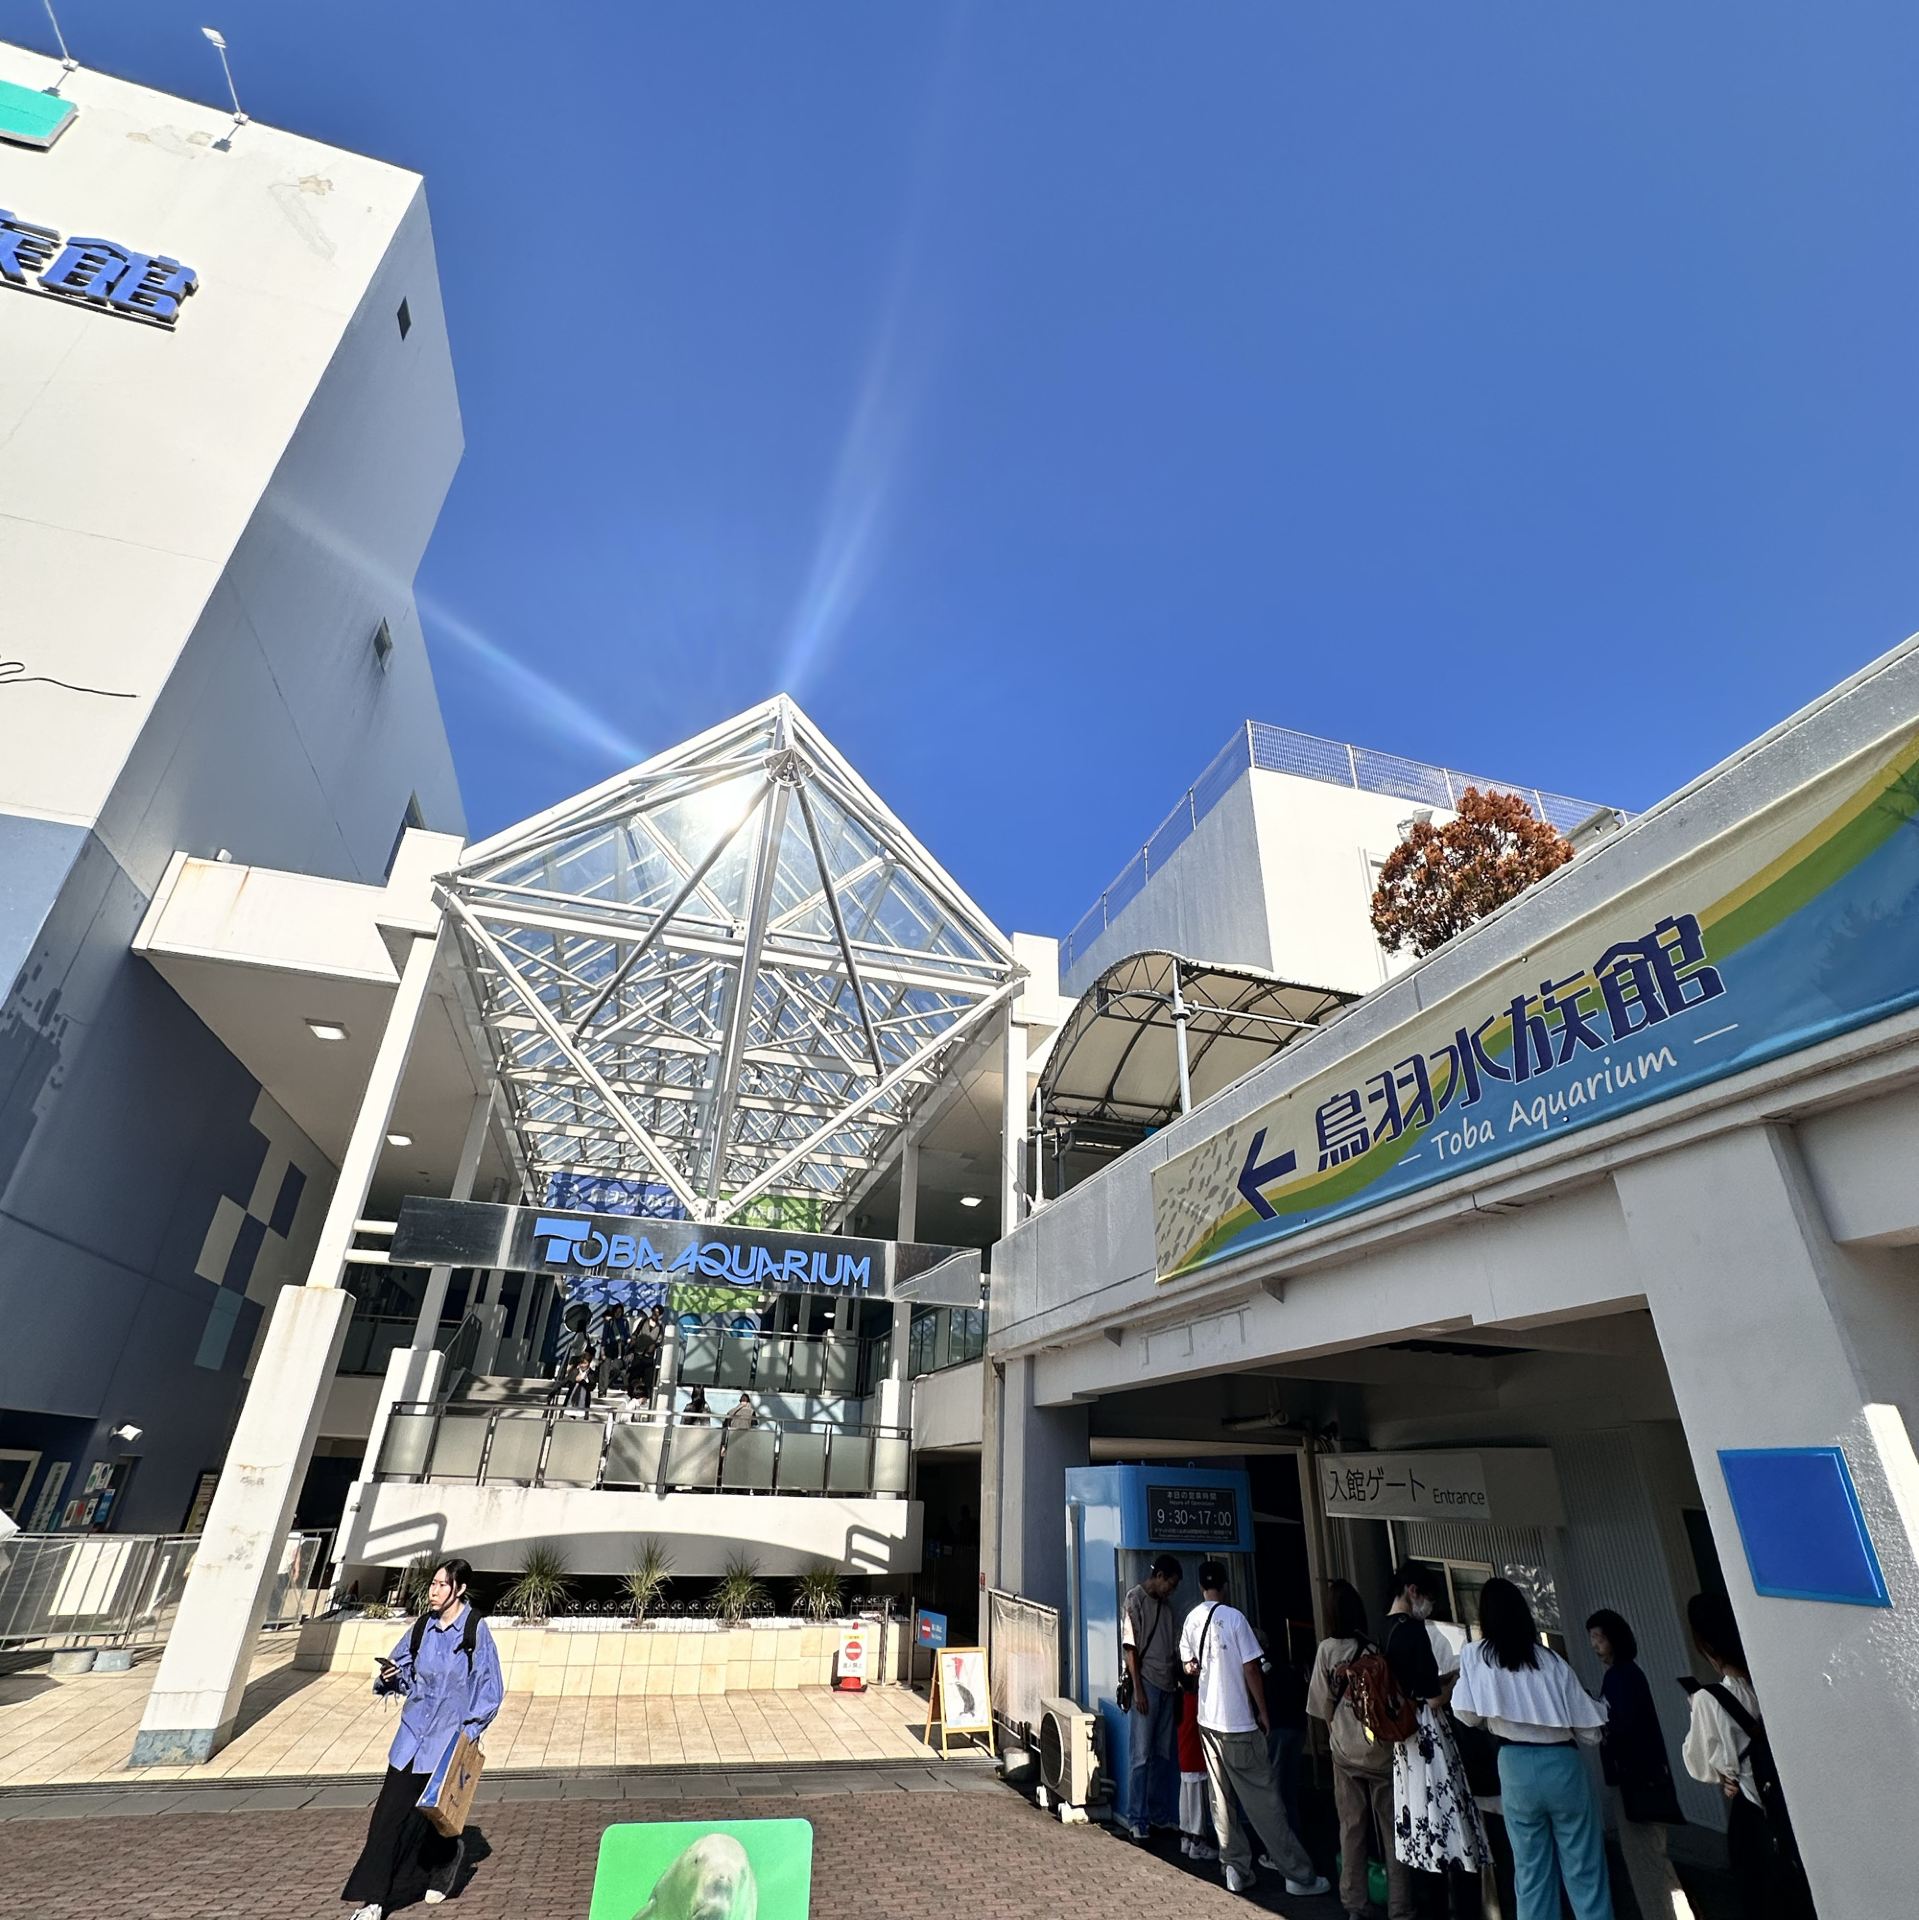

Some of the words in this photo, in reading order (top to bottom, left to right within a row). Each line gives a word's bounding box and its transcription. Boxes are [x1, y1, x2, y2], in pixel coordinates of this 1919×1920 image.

[1315, 913, 1727, 1173] 鳥羽水族館
[1431, 1116, 1496, 1160] Toba
[1508, 1046, 1678, 1133] Aquarium
[532, 1217, 664, 1272] TOBA
[667, 1241, 871, 1289] AQUARIUM
[1329, 1466, 1426, 1502] 入館ゲート
[1432, 1488, 1485, 1505] Entrance
